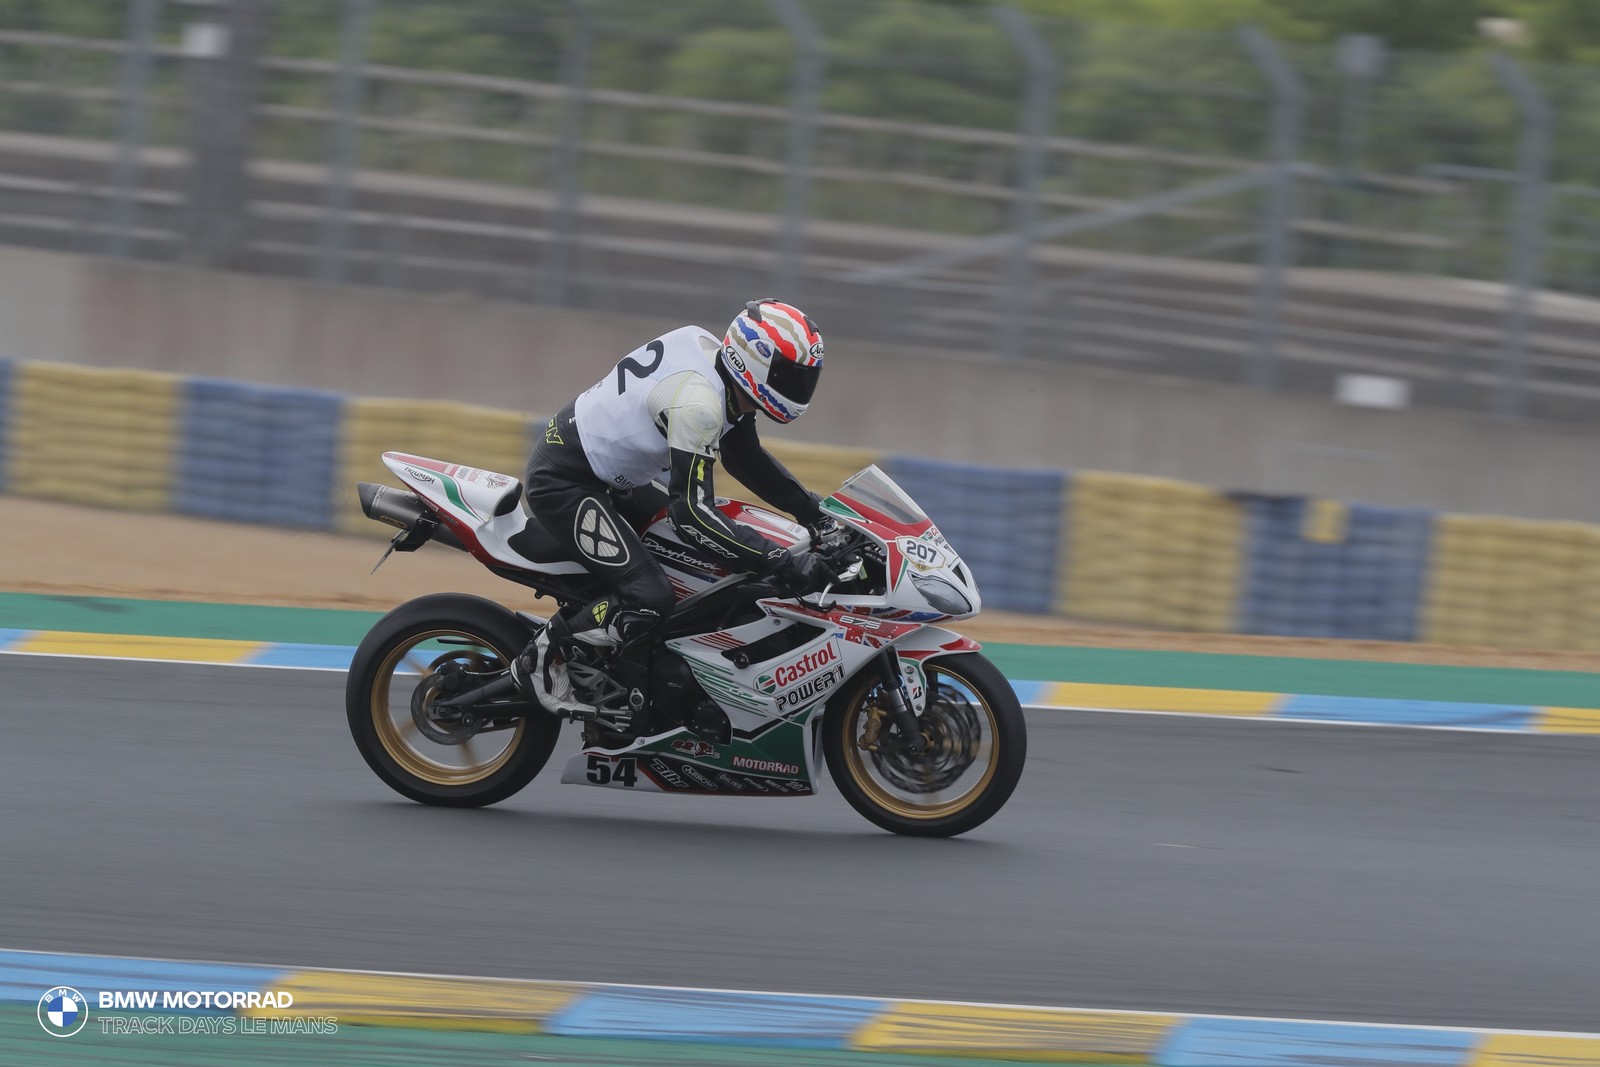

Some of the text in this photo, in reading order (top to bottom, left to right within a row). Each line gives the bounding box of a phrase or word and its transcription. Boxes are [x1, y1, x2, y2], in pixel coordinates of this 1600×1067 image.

[617, 339, 665, 396] 2
[727, 350, 744, 370] Arai
[404, 466, 436, 484] TRIUMPH
[644, 537, 722, 572] Daytona
[906, 540, 937, 564] 207
[838, 615, 883, 630] 675
[774, 641, 837, 688] Castrol
[586, 754, 638, 787] 54
[649, 757, 690, 788] Bihr
[732, 756, 800, 774] MOTORRAD
